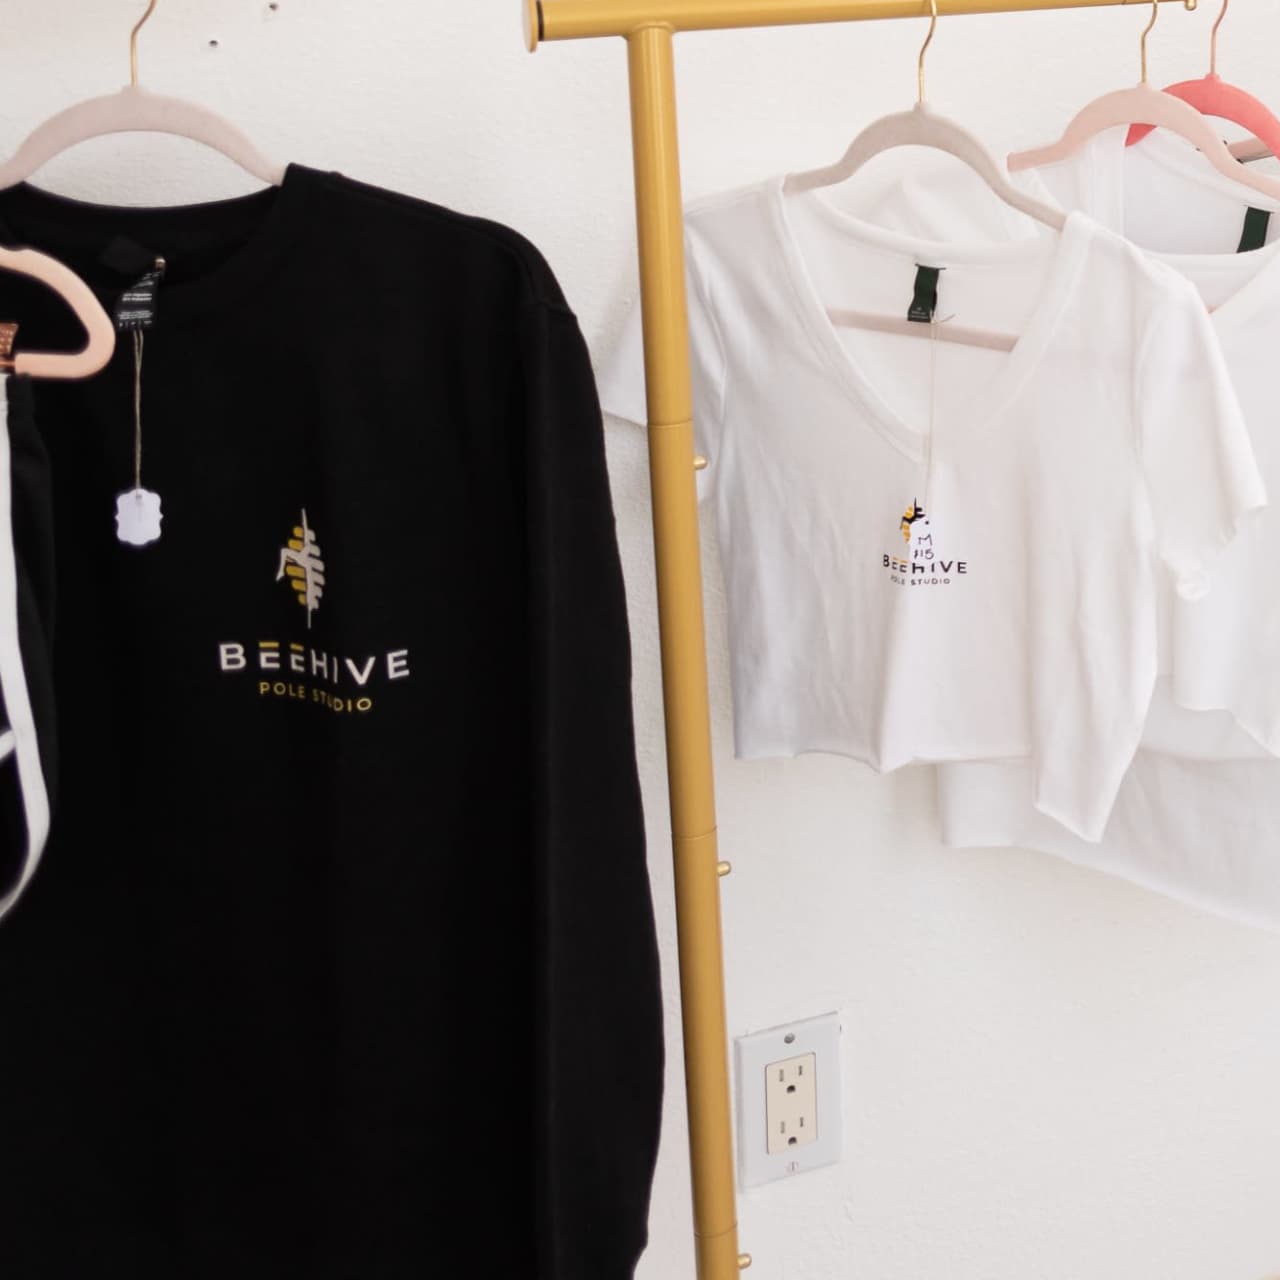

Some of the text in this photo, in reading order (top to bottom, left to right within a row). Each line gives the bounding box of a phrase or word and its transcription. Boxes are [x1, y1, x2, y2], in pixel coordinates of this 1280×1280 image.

[917, 533, 933, 546] M
[913, 548, 935, 561] $15
[883, 553, 968, 574] BEEHIVE
[910, 577, 951, 586] STUDIO
[219, 641, 410, 685] BEEHIVE
[260, 681, 372, 712] POLE STUDIO
